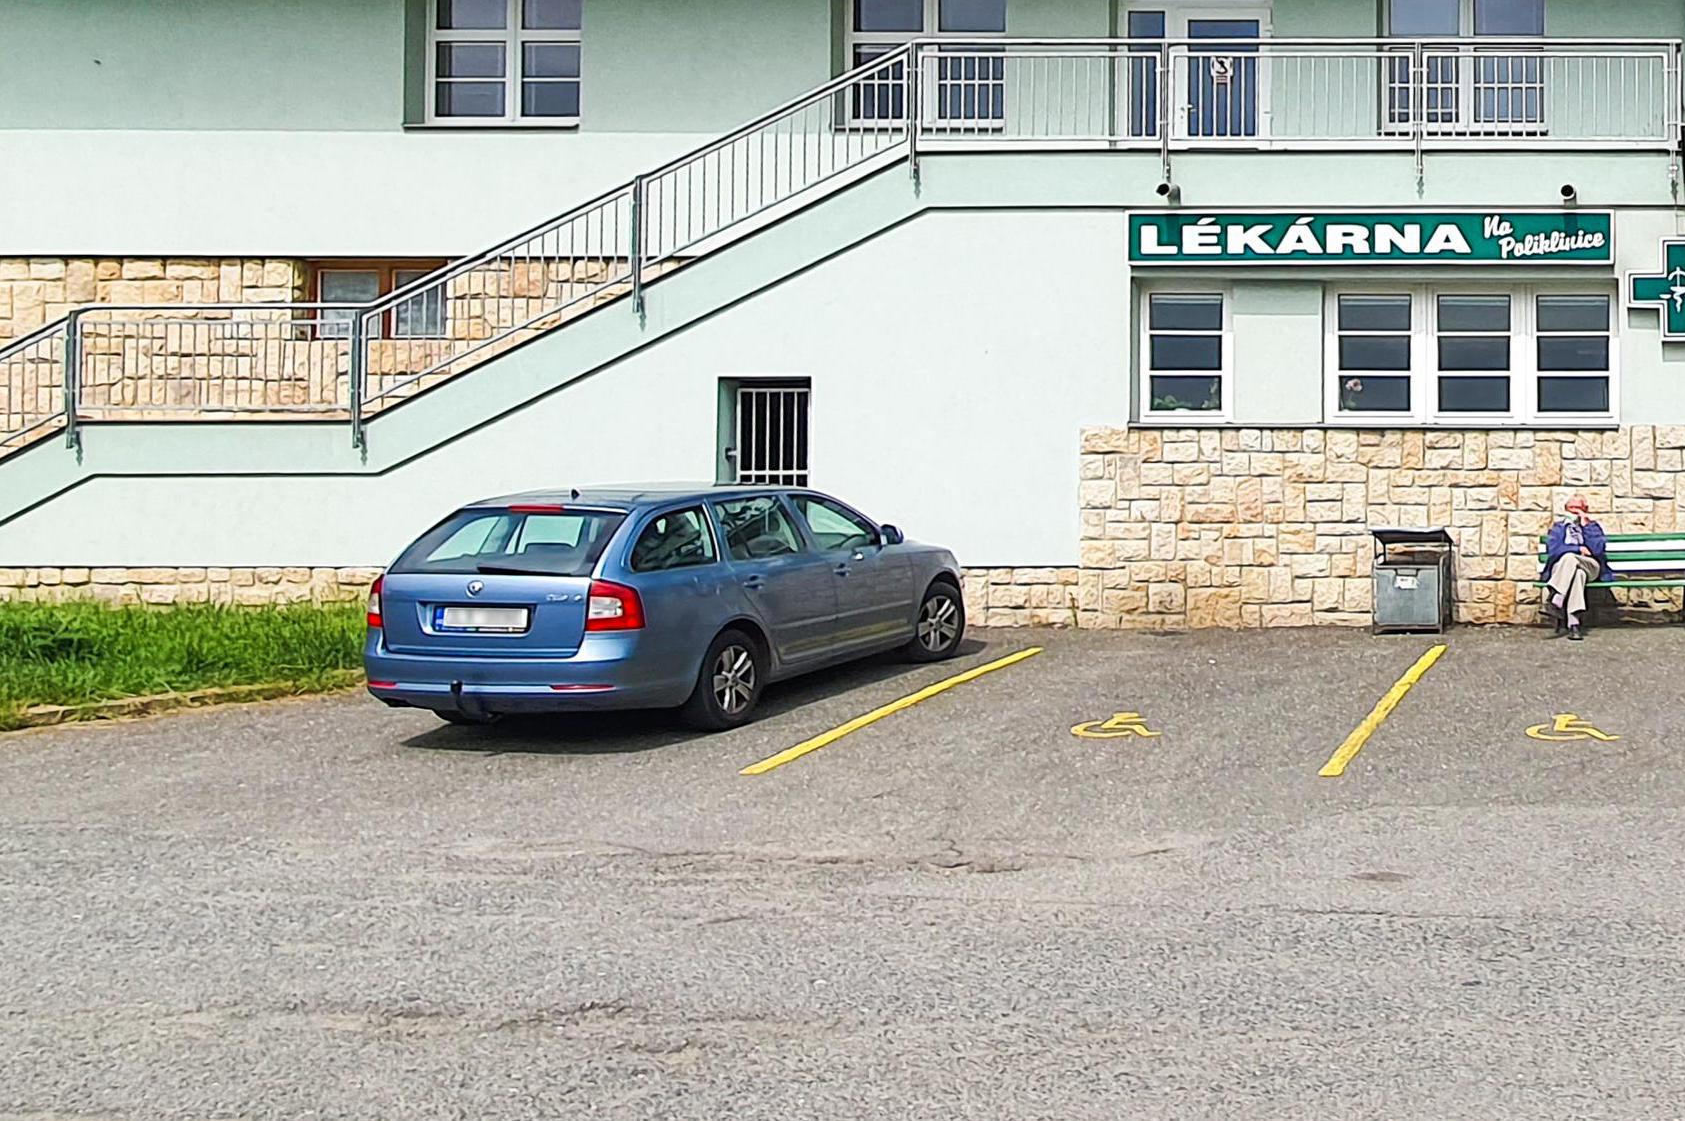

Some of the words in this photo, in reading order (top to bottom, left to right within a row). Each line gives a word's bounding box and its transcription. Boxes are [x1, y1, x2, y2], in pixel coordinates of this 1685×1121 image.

[1140, 217, 1472, 254] LÉKÁRNA
[1484, 215, 1513, 238] Na
[1499, 230, 1606, 259] Poliklinice
